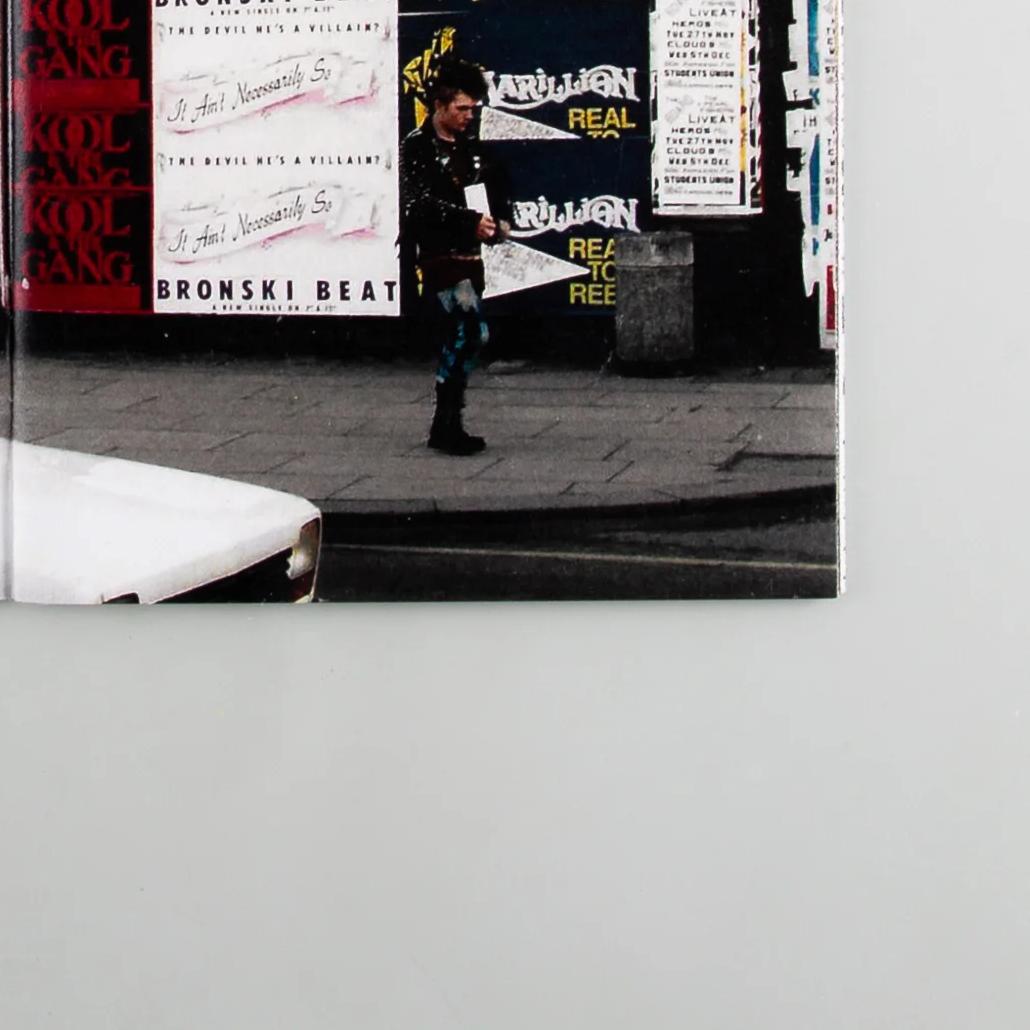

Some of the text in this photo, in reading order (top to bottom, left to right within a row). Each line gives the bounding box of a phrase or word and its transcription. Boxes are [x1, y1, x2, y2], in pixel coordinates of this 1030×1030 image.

[689, 8, 720, 17] LIVE
[169, 23, 379, 35] THE DEVIL HE'S A VILLAIN?
[20, 45, 132, 78] GANG
[664, 69, 707, 77] STUDENTS
[232, 62, 305, 110] Necessarily
[309, 57, 331, 82] So
[568, 107, 637, 130] REAL
[689, 114, 717, 124] LIVE
[23, 113, 131, 152] KOOL
[169, 155, 380, 166] THE DEVIL HE'S A VILLAIN?
[664, 175, 707, 183] STUDENTS
[23, 194, 131, 235] KOOL
[233, 195, 306, 241] Necessarily
[310, 189, 332, 214] So
[513, 194, 640, 237] RILLION
[569, 238, 616, 259] REA
[21, 250, 134, 283] GANG
[157, 279, 397, 302] BRONSKI BEAT
[570, 283, 616, 305] REE
